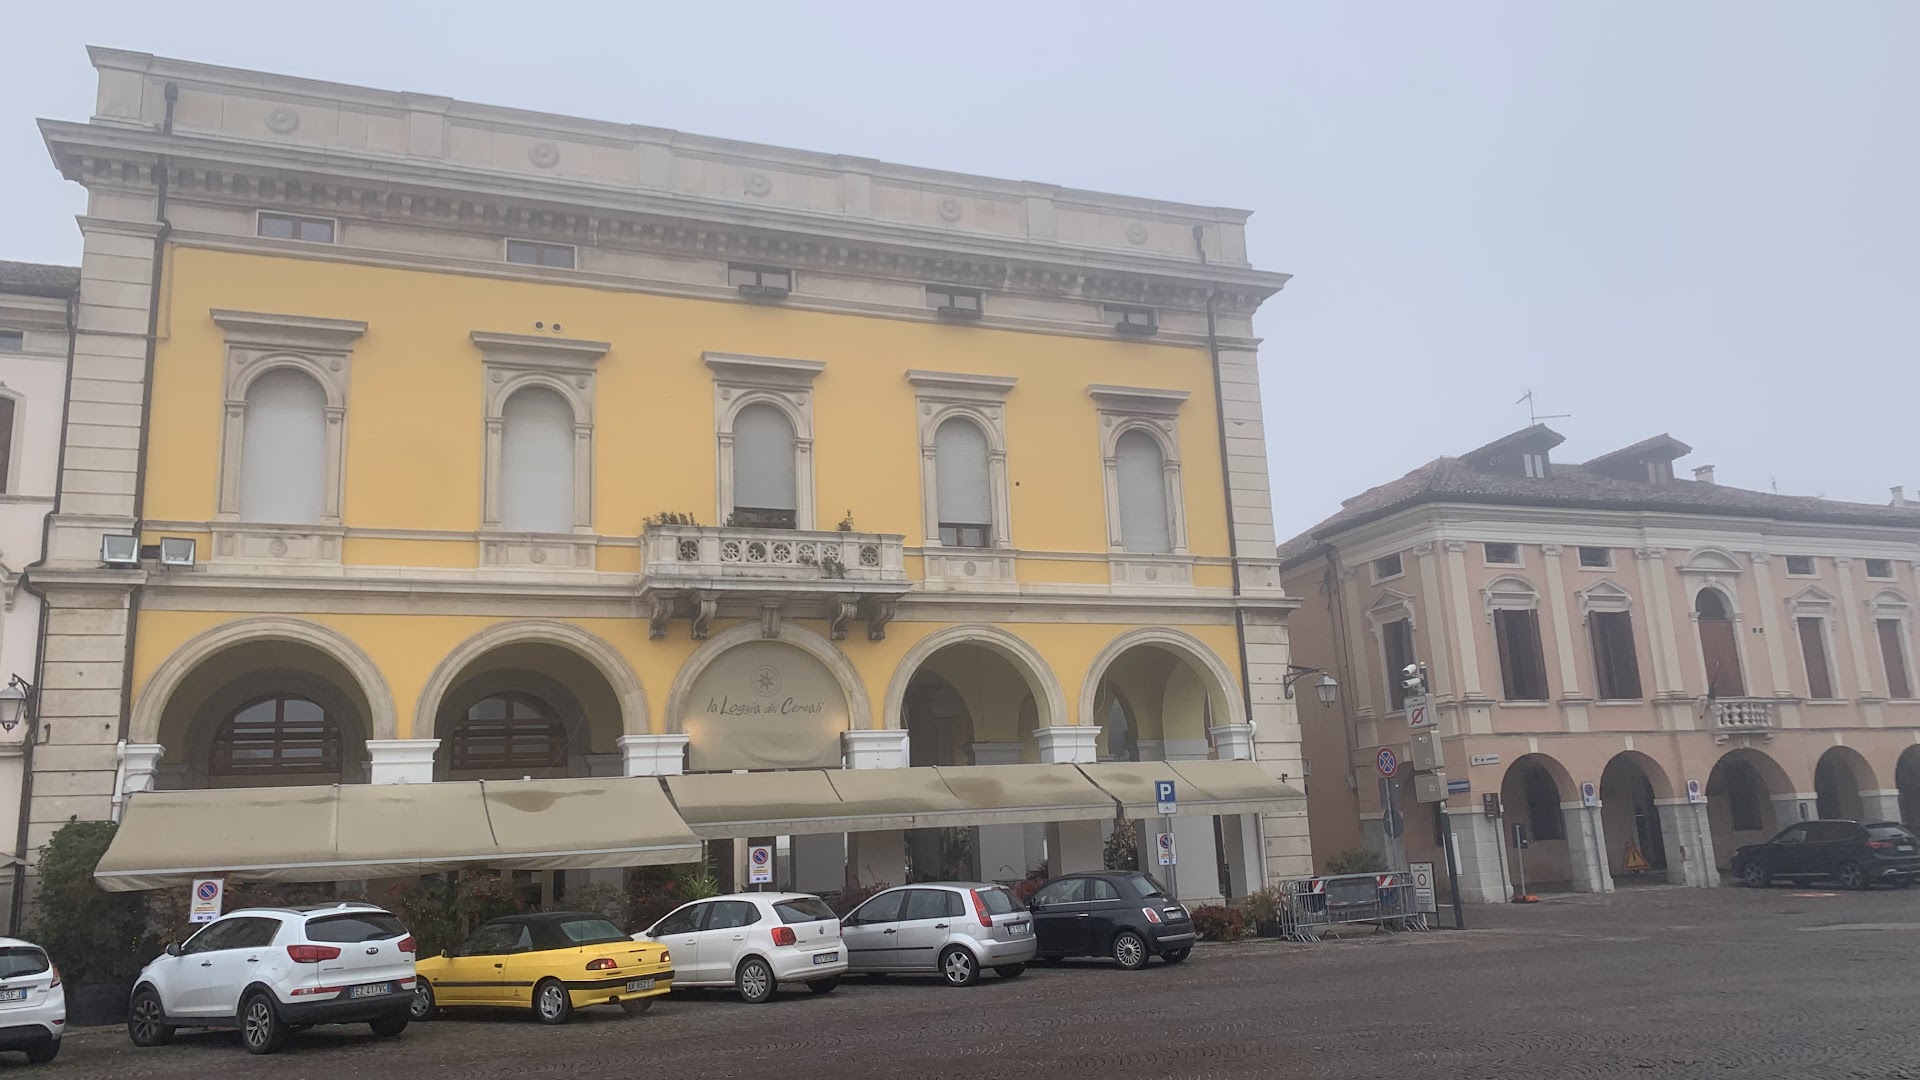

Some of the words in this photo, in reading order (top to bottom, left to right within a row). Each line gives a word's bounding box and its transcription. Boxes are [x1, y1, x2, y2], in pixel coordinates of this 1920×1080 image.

[706, 697, 718, 713] la
[720, 695, 761, 716] Loggia
[763, 702, 780, 714] dei
[781, 697, 824, 715] Cereali
[1160, 783, 1172, 801] P
